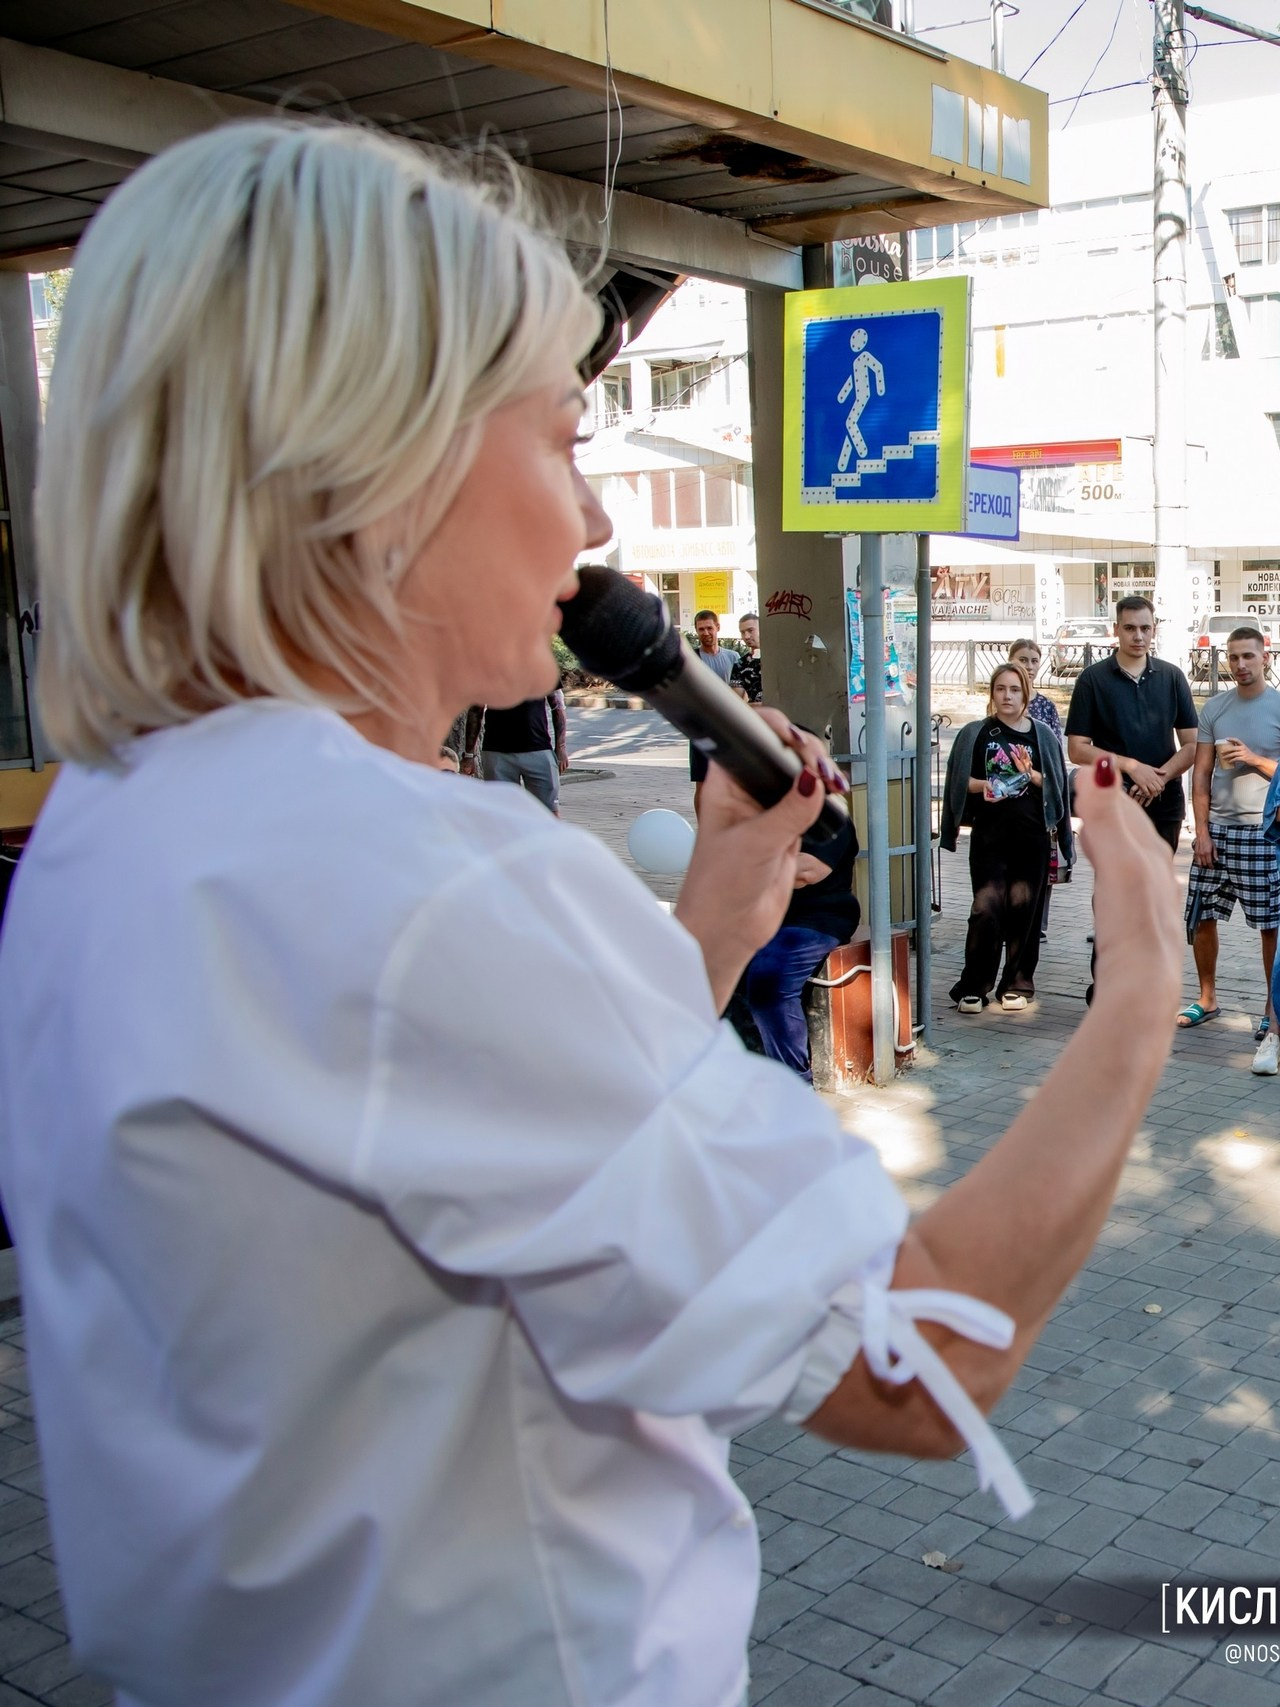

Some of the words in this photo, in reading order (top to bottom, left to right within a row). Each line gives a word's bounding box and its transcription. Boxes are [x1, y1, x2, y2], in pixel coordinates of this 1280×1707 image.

[842, 248, 903, 282] house
[969, 491, 1012, 518] ЕРЕХОД
[1132, 580, 1155, 588] КОЛЛЕКЦ
[931, 604, 989, 615] VALANCHE
